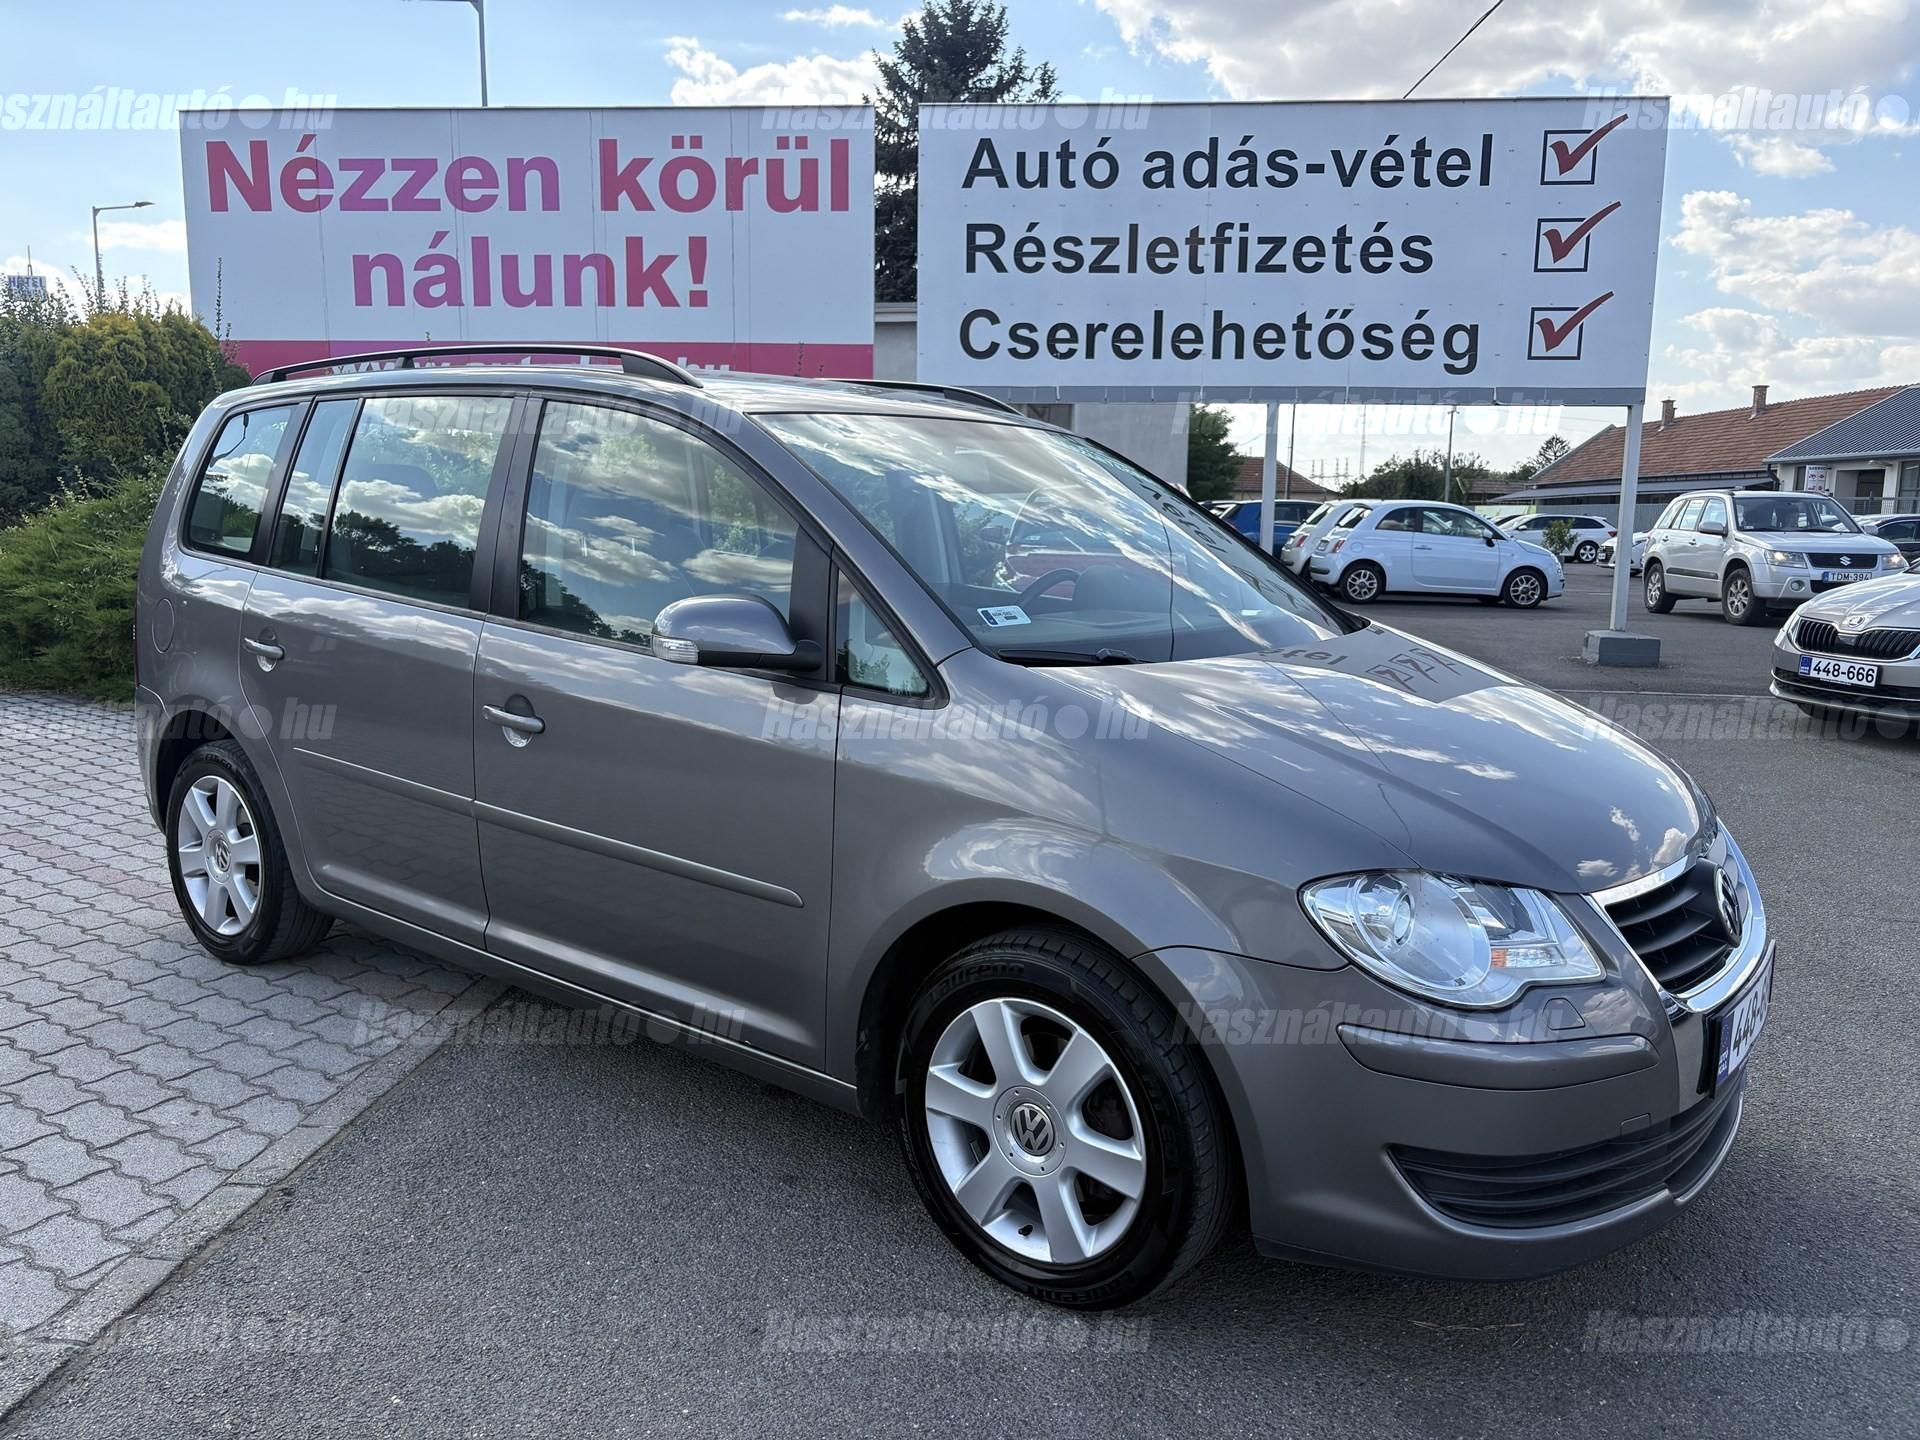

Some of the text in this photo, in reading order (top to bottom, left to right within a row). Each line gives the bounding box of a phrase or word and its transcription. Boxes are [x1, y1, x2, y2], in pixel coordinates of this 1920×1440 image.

[205, 134, 850, 213] Nézzen körül
[962, 134, 1493, 190] Autó adás-vétel
[352, 231, 709, 308] nálunk!
[966, 221, 1434, 275] Részletfizetés
[959, 307, 1479, 376] Cserelehetőség
[1812, 660, 1876, 683] 448-666
